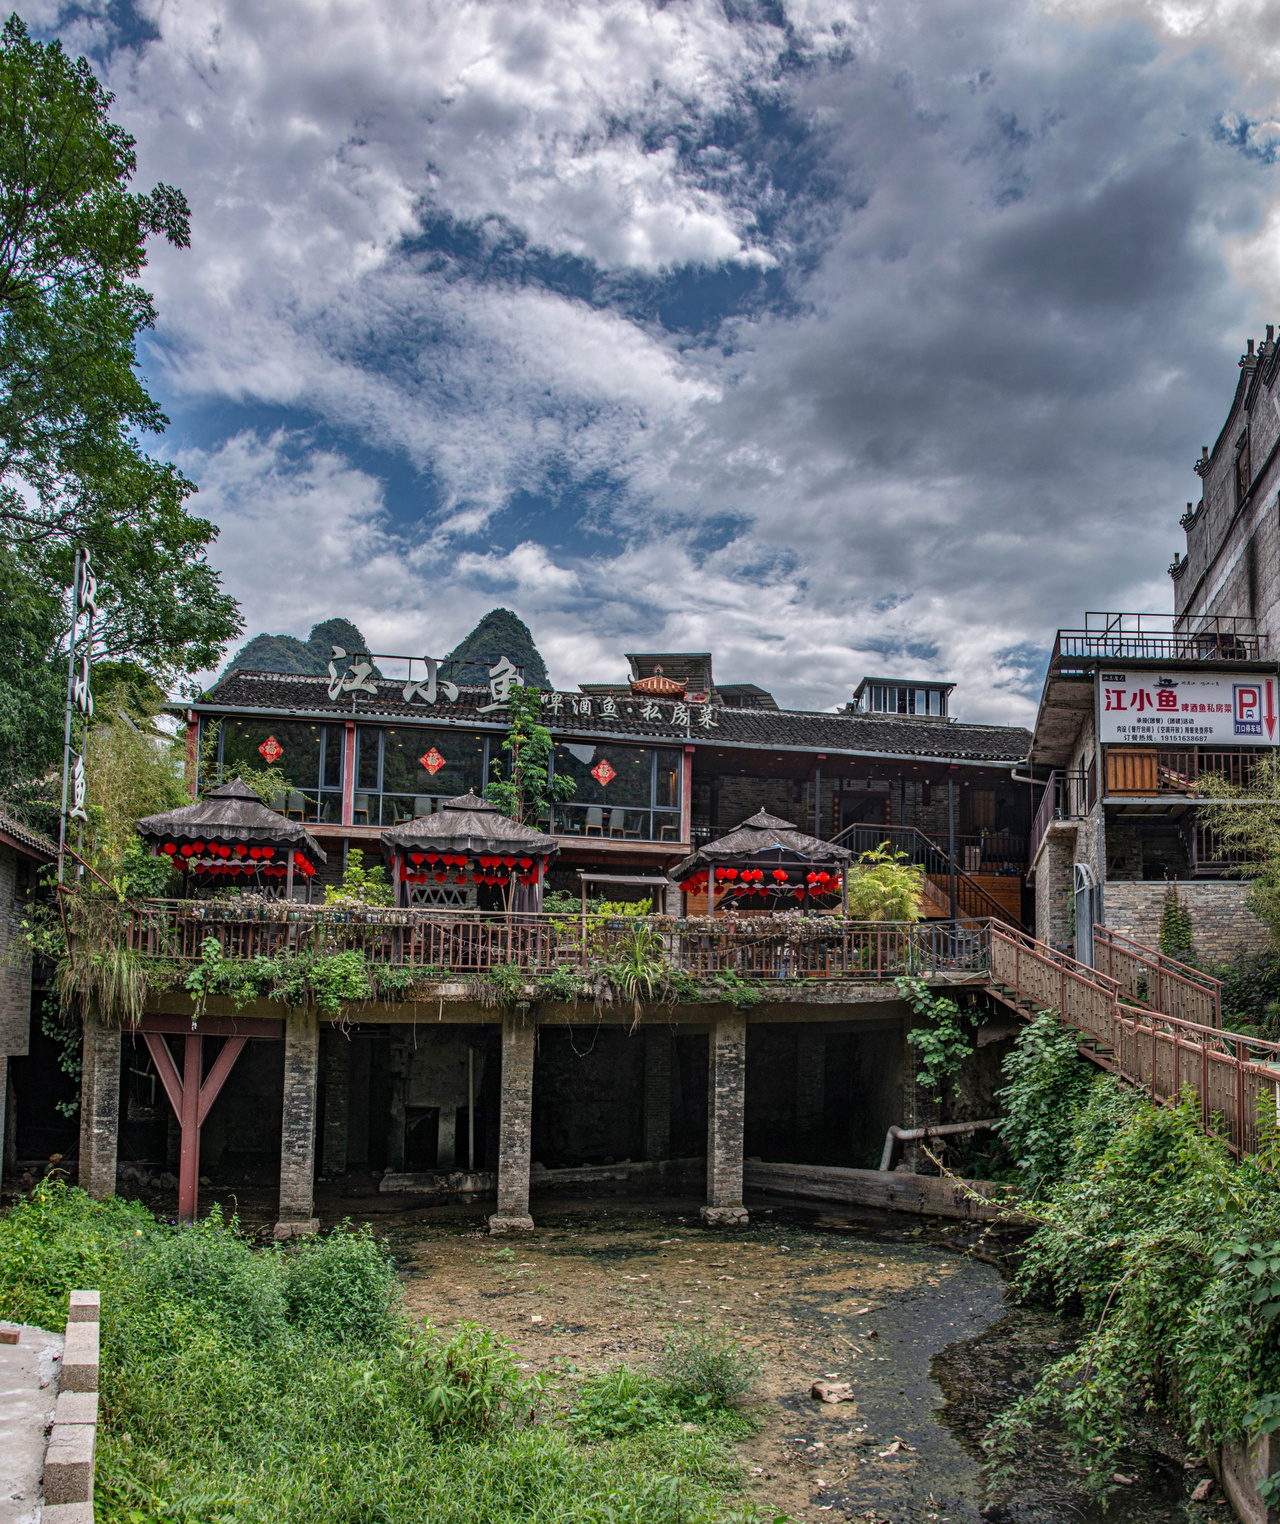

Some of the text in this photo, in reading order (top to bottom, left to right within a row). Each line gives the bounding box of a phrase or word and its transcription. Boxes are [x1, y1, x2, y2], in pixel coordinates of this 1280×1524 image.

[327, 645, 529, 713] 江小鱼
[1105, 688, 1232, 713] 江小鱼 啤酒鱼私房菜
[1238, 689, 1257, 719] P
[1235, 724, 1262, 733] 门口停车场
